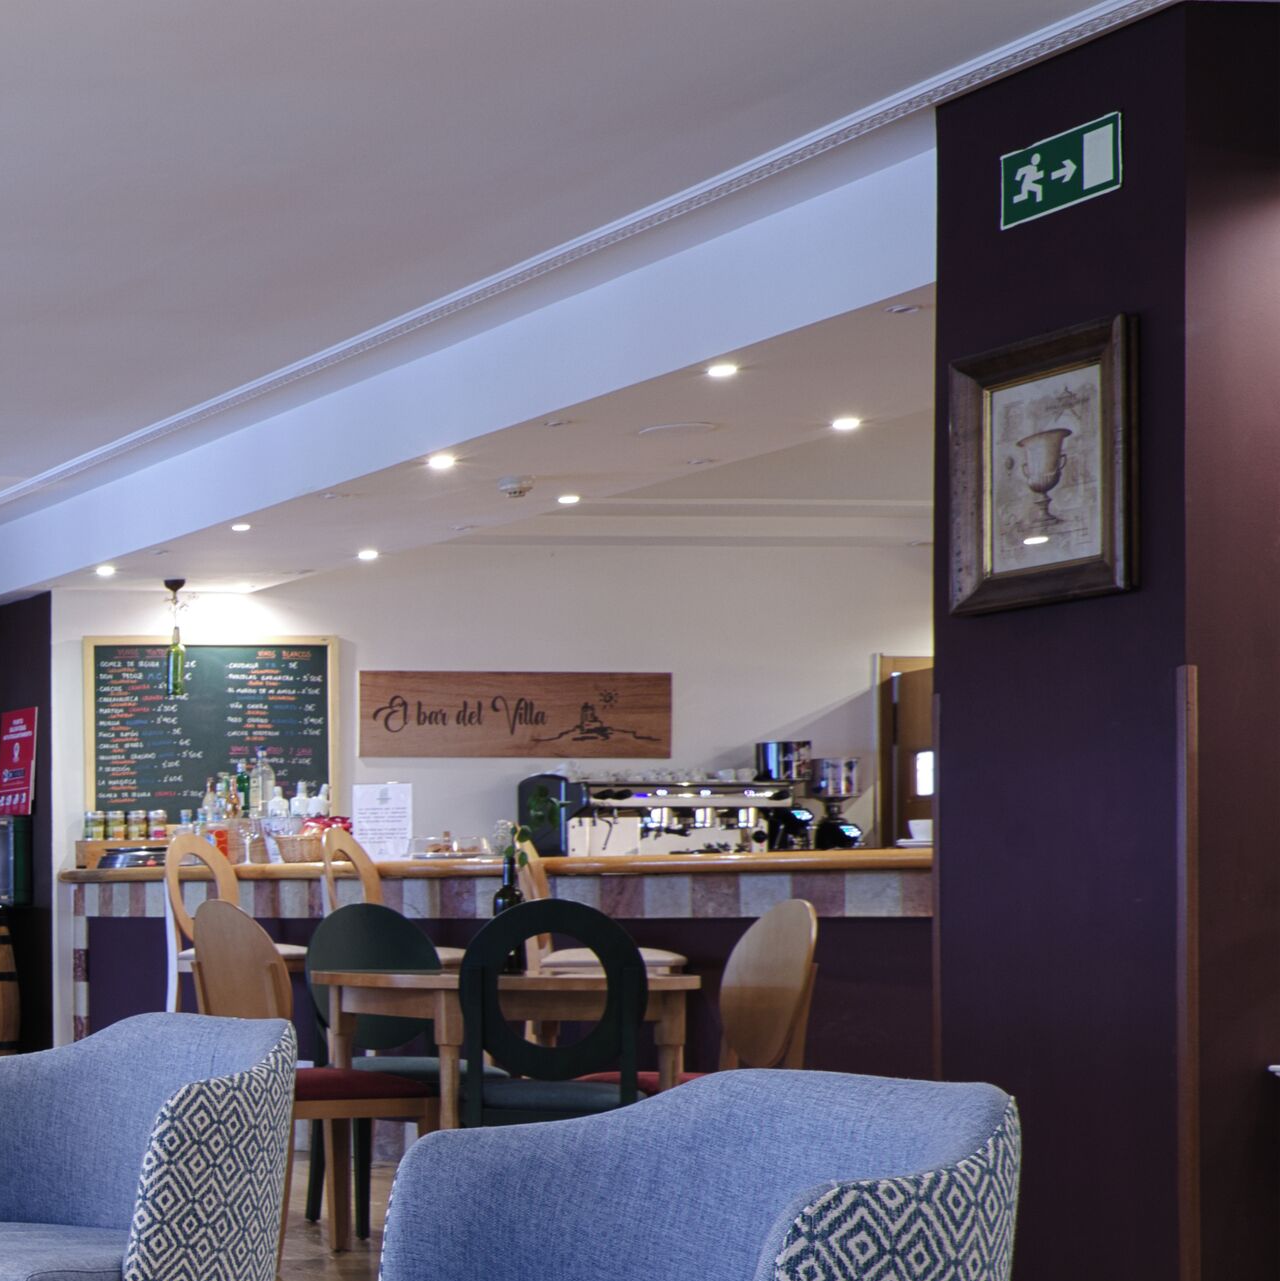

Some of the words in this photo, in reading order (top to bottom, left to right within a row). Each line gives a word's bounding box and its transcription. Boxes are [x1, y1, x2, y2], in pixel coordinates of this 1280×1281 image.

[372, 695, 409, 734] El
[416, 699, 449, 727] bar
[455, 699, 484, 727] del
[491, 695, 547, 736] Villa
